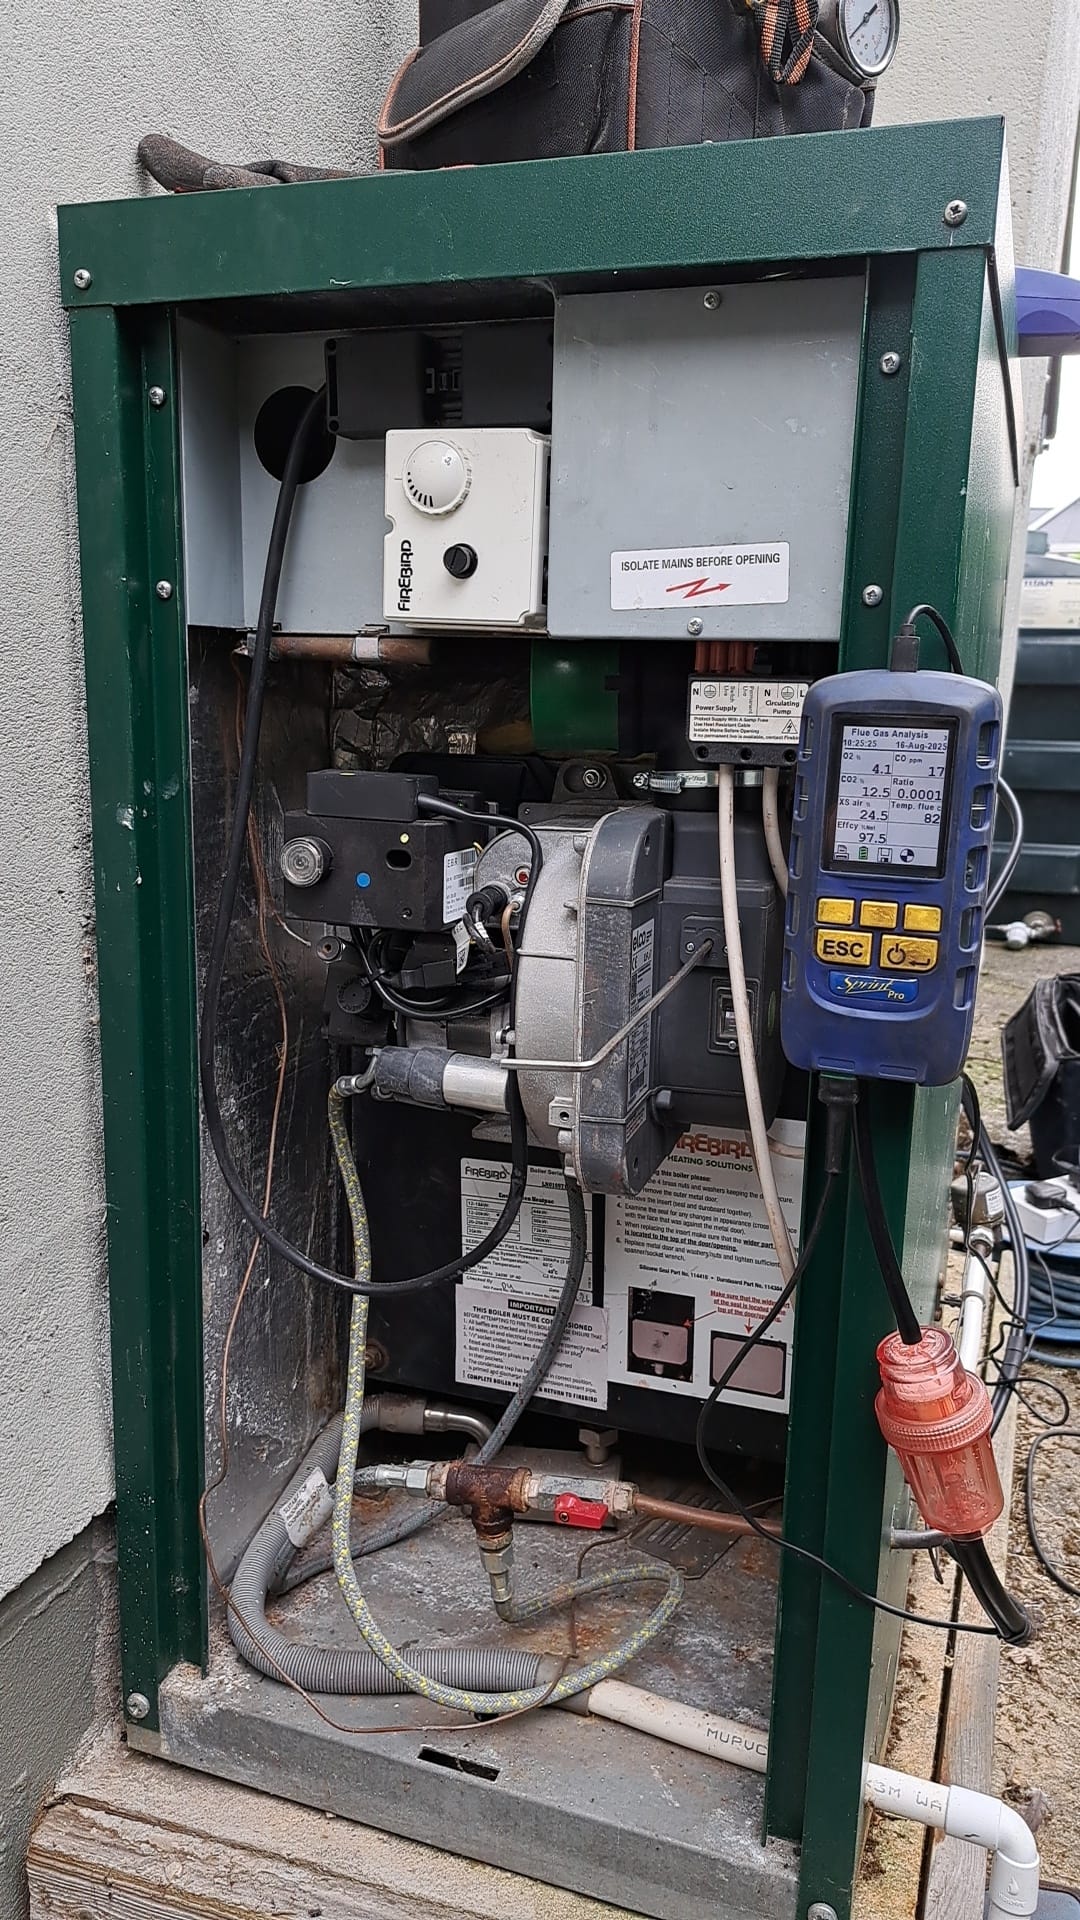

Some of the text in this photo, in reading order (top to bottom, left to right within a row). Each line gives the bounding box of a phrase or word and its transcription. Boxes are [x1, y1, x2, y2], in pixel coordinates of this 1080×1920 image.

[621, 552, 781, 571] ISOLATE MAINS BEFORE OPENING
[692, 688, 700, 696] N
[764, 689, 771, 697] N
[765, 700, 800, 708] Circulating
[851, 728, 929, 740] Flue Gas Analysis
[844, 739, 947, 750] 10:25:25 16-Aug-2025
[872, 764, 892, 774] 4.1
[928, 767, 945, 777] 17
[892, 778, 914, 786] Ratio
[862, 787, 890, 798] 12.5
[898, 789, 942, 800] 0.0001
[852, 799, 863, 807] air
[891, 801, 915, 810] Temp.
[918, 803, 934, 811] flue
[860, 810, 888, 820] 24.5
[924, 814, 940, 824] 82
[837, 821, 859, 830] Effcy
[858, 833, 886, 844] 97.5
[822, 940, 864, 958] ESC
[836, 977, 894, 994] Sprint
[888, 991, 905, 1000] Pro
[668, 1155, 754, 1172] HEATING SOLUTIONS
[660, 1169, 712, 1185] this boiler please:
[677, 1181, 690, 1189] nuts
[691, 1183, 701, 1191] and
[702, 1185, 725, 1194] washers
[726, 1189, 748, 1199] keeping
[688, 1193, 704, 1201] metal
[624, 1203, 647, 1212] Examine
[689, 1213, 712, 1223] changes
[719, 1219, 751, 1229] appearance
[624, 1221, 640, 1229] When
[640, 1223, 664, 1233] replacing
[675, 1228, 690, 1236] insert
[691, 1231, 706, 1239] make
[743, 1239, 760, 1247] wider
[761, 1241, 773, 1250] part
[630, 1230, 652, 1239] located
[472, 1306, 487, 1314] THIS
[488, 1308, 511, 1317] BOILER
[512, 1312, 530, 1320] MUST
[510, 1301, 554, 1315] IMPORTANT
